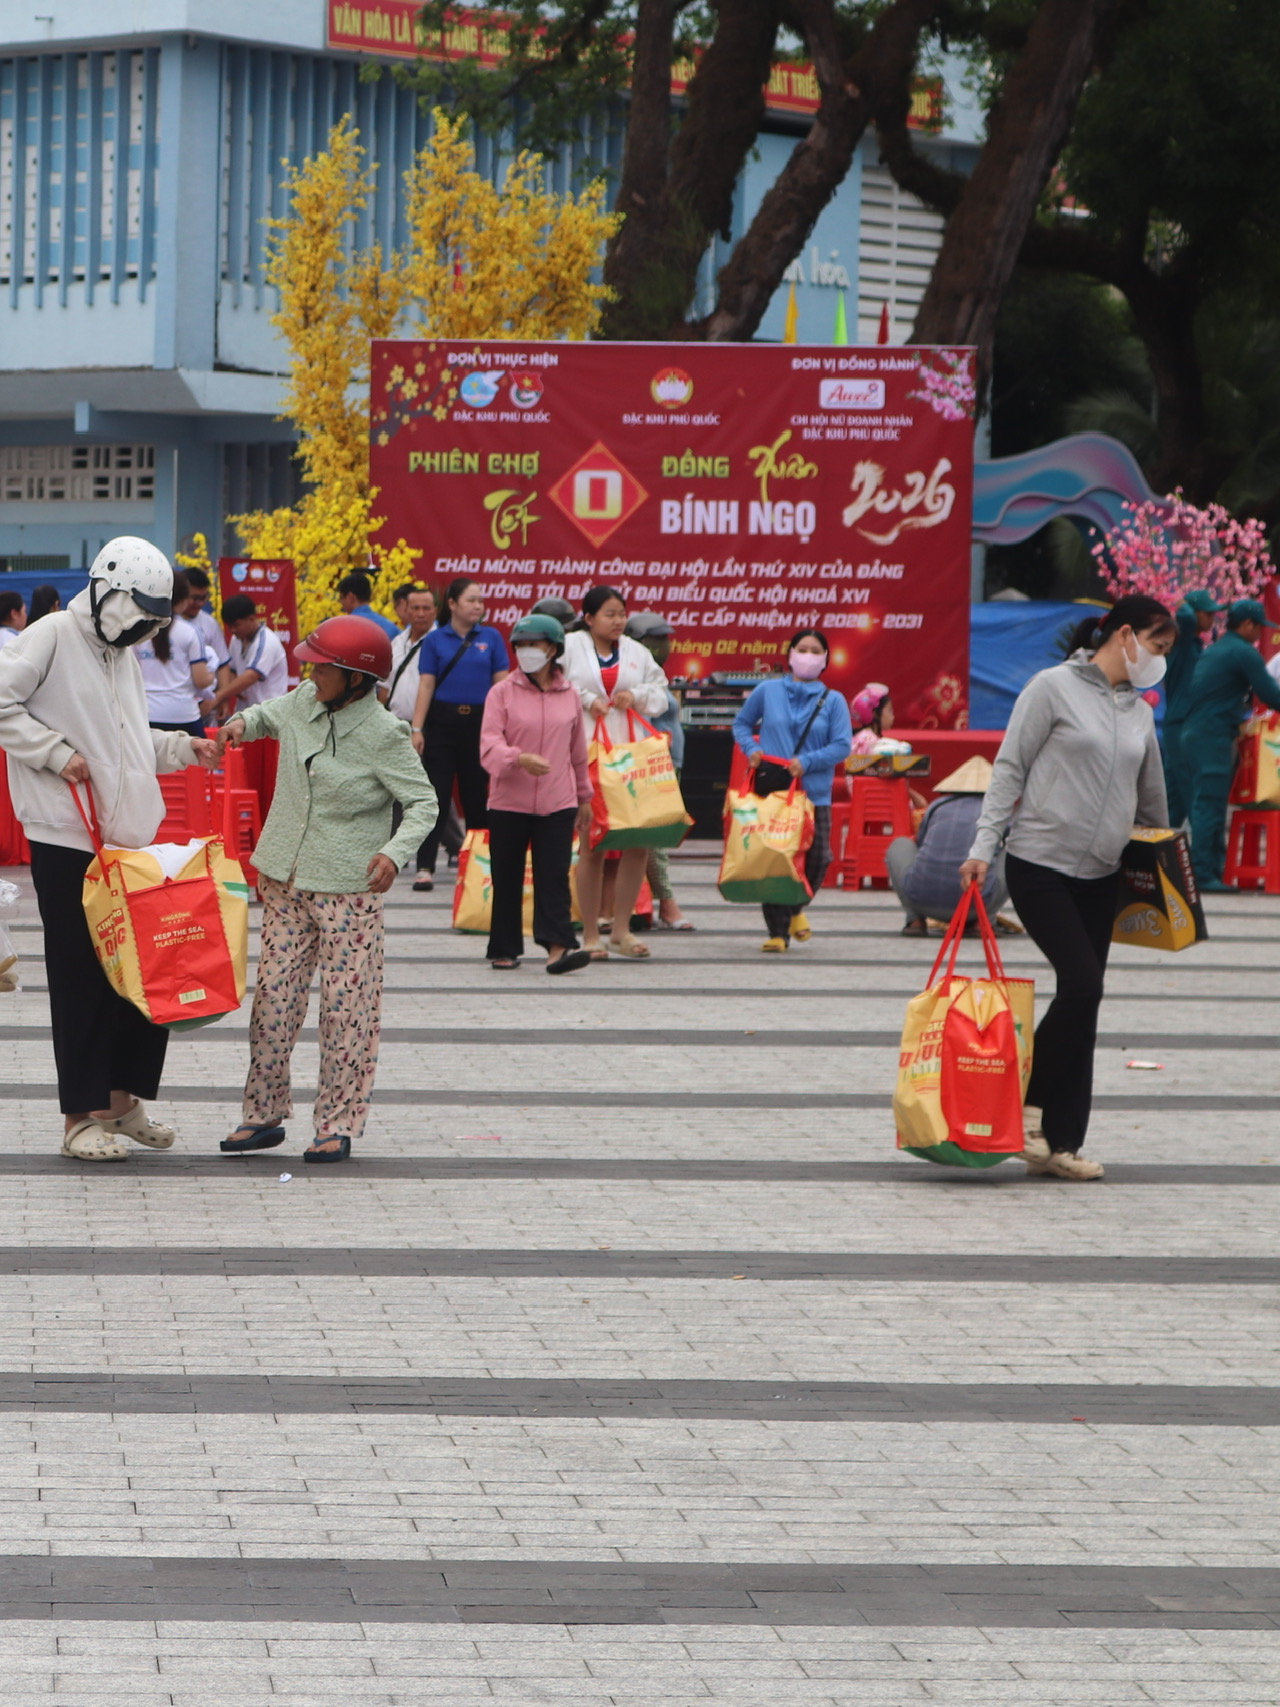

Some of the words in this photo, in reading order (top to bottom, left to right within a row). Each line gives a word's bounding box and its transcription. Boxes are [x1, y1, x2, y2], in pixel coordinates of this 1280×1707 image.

[334, 2, 362, 37] VĂN
[364, 6, 392, 41] HÓA
[394, 10, 412, 44] LÀ
[447, 352, 477, 366] ĐƠN
[478, 353, 492, 368] VỊ
[494, 353, 528, 368] THỰC
[530, 352, 559, 368] HIỆN
[791, 357, 821, 371] ĐƠN
[823, 357, 837, 374] VỊ
[477, 410, 498, 424] KHU
[646, 413, 668, 427] KHU
[790, 415, 808, 427] CHI
[847, 415, 883, 427] DOANH
[826, 428, 847, 441] KHU
[408, 447, 480, 474] PHIÊN
[487, 450, 541, 480] CHỢ
[842, 457, 956, 543] 2026
[660, 492, 739, 535] BÍNH
[748, 499, 817, 544] NGỌ
[434, 554, 481, 573] CHÀO
[483, 555, 536, 574] MỪNG
[540, 555, 596, 576] THÀNH
[598, 556, 646, 577] CÔNG
[648, 561, 677, 580] ĐẠI
[679, 558, 710, 580] HỘI
[750, 559, 786, 579] THỨ
[787, 563, 818, 579] XIV
[820, 558, 853, 579] CỦA
[856, 559, 905, 580] ĐẢNG
[634, 585, 664, 605] ĐẠI
[708, 580, 756, 603] QUỐC
[757, 584, 788, 607] HỘI
[789, 584, 838, 604] KHOÁ
[840, 588, 870, 604] XVI
[666, 608, 699, 627] CÁC
[738, 608, 793, 630] NHIỆM
[882, 613, 924, 630] 2031
[670, 638, 713, 658] háng
[715, 639, 739, 655] 02
[172, 928, 188, 937] THE
